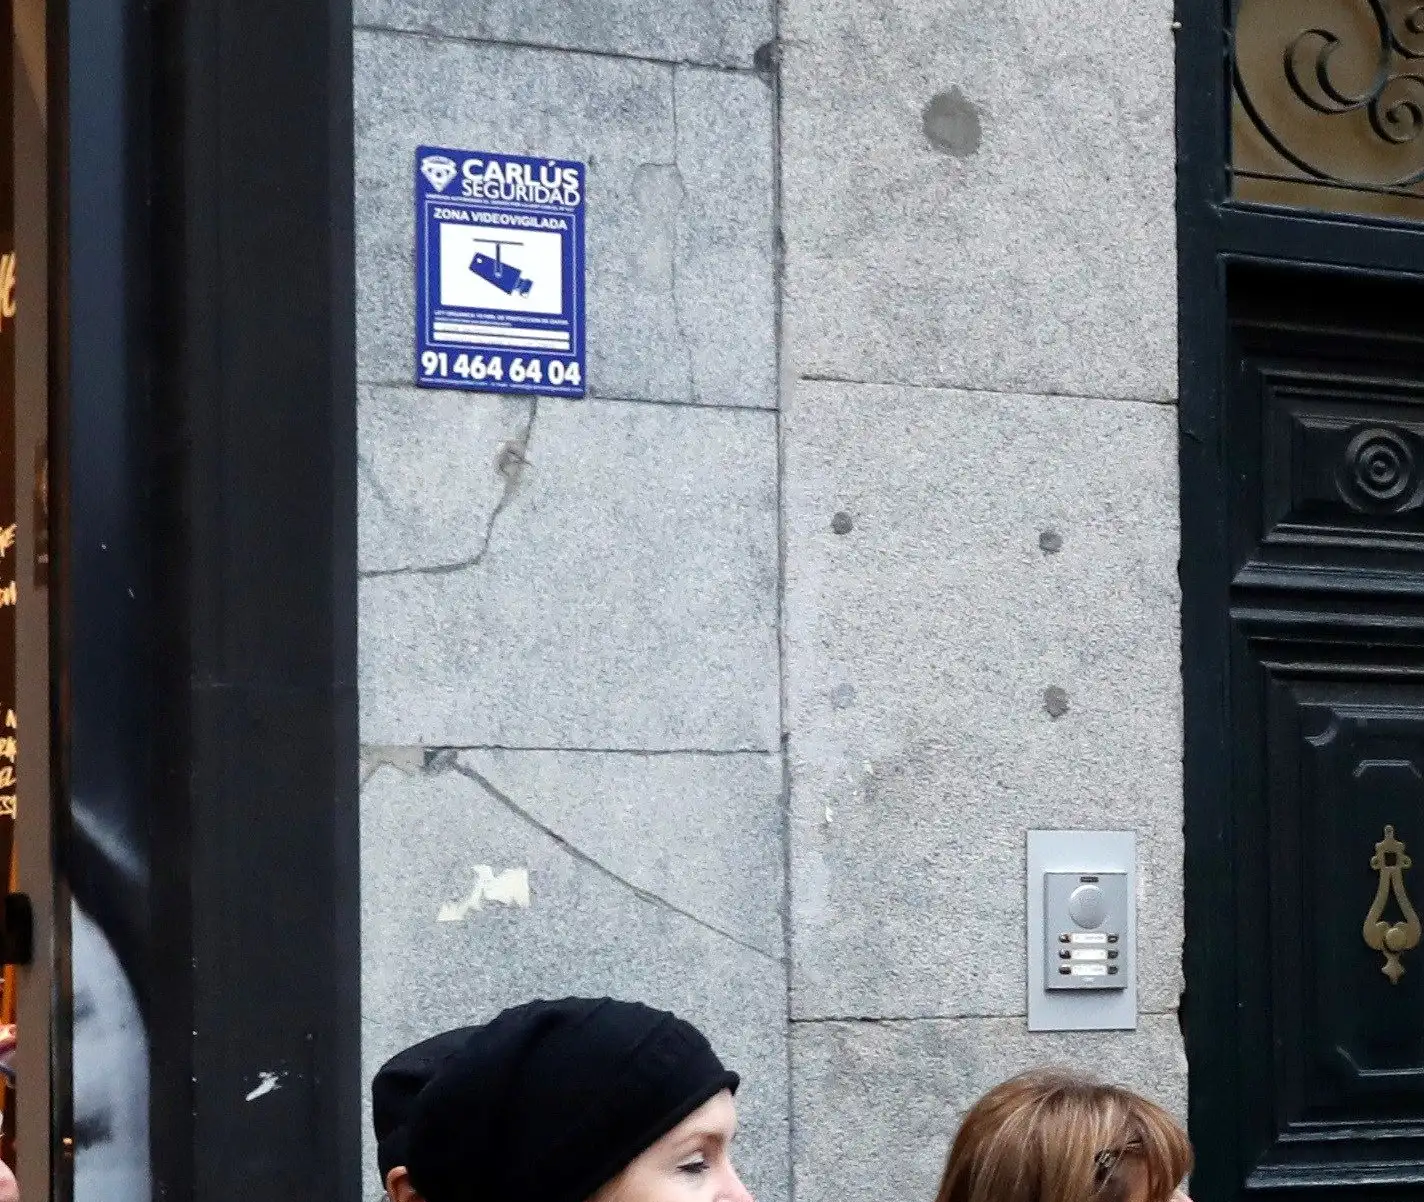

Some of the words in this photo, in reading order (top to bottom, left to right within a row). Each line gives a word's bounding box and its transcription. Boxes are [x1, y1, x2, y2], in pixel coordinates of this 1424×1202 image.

[462, 159, 579, 191] CARLÚS
[461, 179, 581, 206] SEGURIDAD
[433, 207, 470, 222] ZONA
[471, 211, 568, 231] VIDEOVIGILADA
[421, 351, 448, 377] 91
[453, 353, 503, 380] 464
[509, 357, 542, 383] 64
[548, 360, 581, 385] 04
